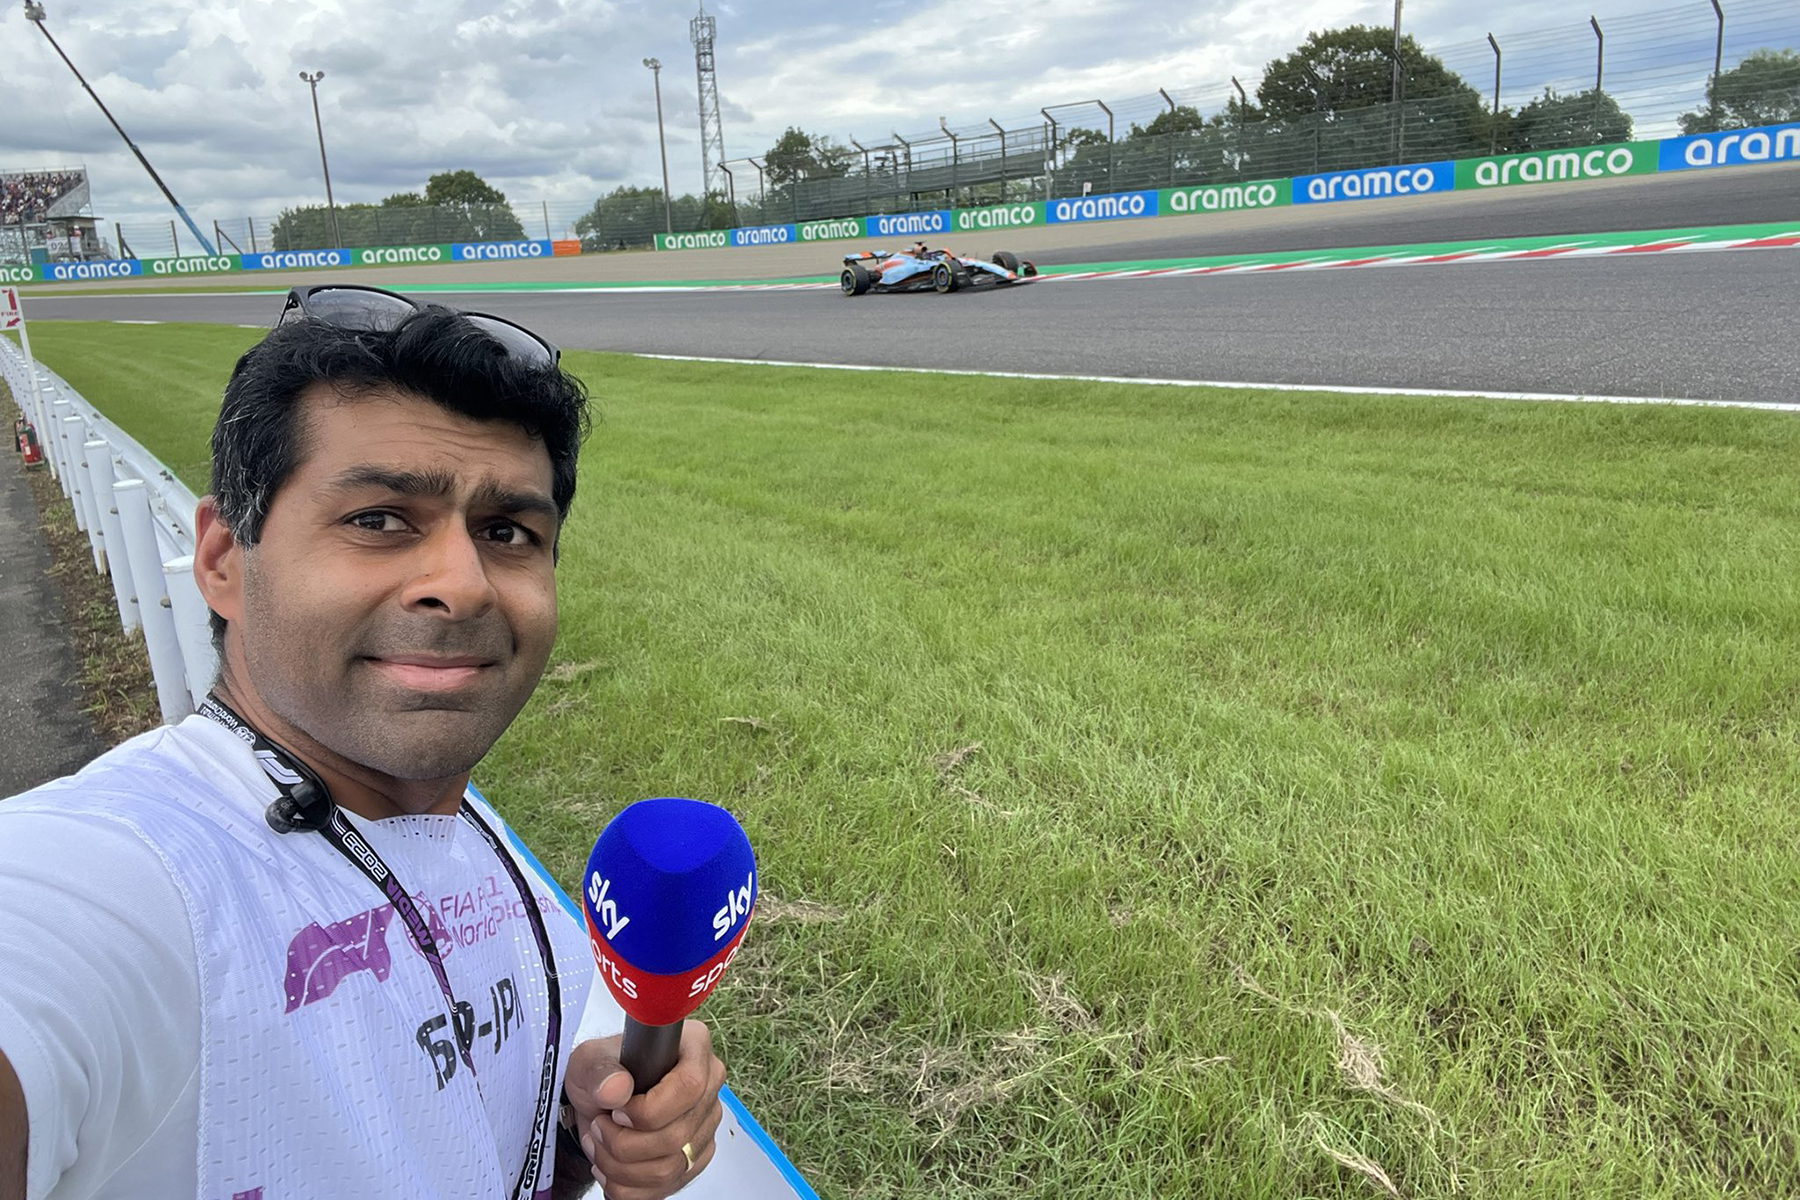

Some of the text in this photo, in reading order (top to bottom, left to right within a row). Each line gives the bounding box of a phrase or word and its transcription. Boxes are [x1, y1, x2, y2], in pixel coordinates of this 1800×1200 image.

[1684, 129, 1800, 166] aram
[1475, 149, 1633, 186] aramco
[1308, 168, 1434, 200] aramco
[1056, 195, 1145, 220] aramco
[1170, 185, 1276, 211] aramco
[879, 214, 942, 234] aramco
[959, 206, 1035, 229] aramco
[664, 232, 726, 250] aramco
[737, 227, 788, 245] aramco
[803, 221, 859, 240] aramco
[261, 252, 340, 268] aramco
[362, 247, 441, 264] aramco
[462, 242, 542, 259] aramco
[0, 267, 33, 282] mco
[54, 262, 131, 279] aramco
[153, 257, 231, 274] aramco
[342, 831, 389, 883] 2023
[386, 876, 432, 947] MEDIA
[440, 892, 476, 922] FIA
[588, 870, 630, 940] sky
[712, 871, 753, 941] sky
[591, 939, 638, 999] orts
[688, 946, 738, 998] spo
[524, 1138, 540, 1190] GRID
